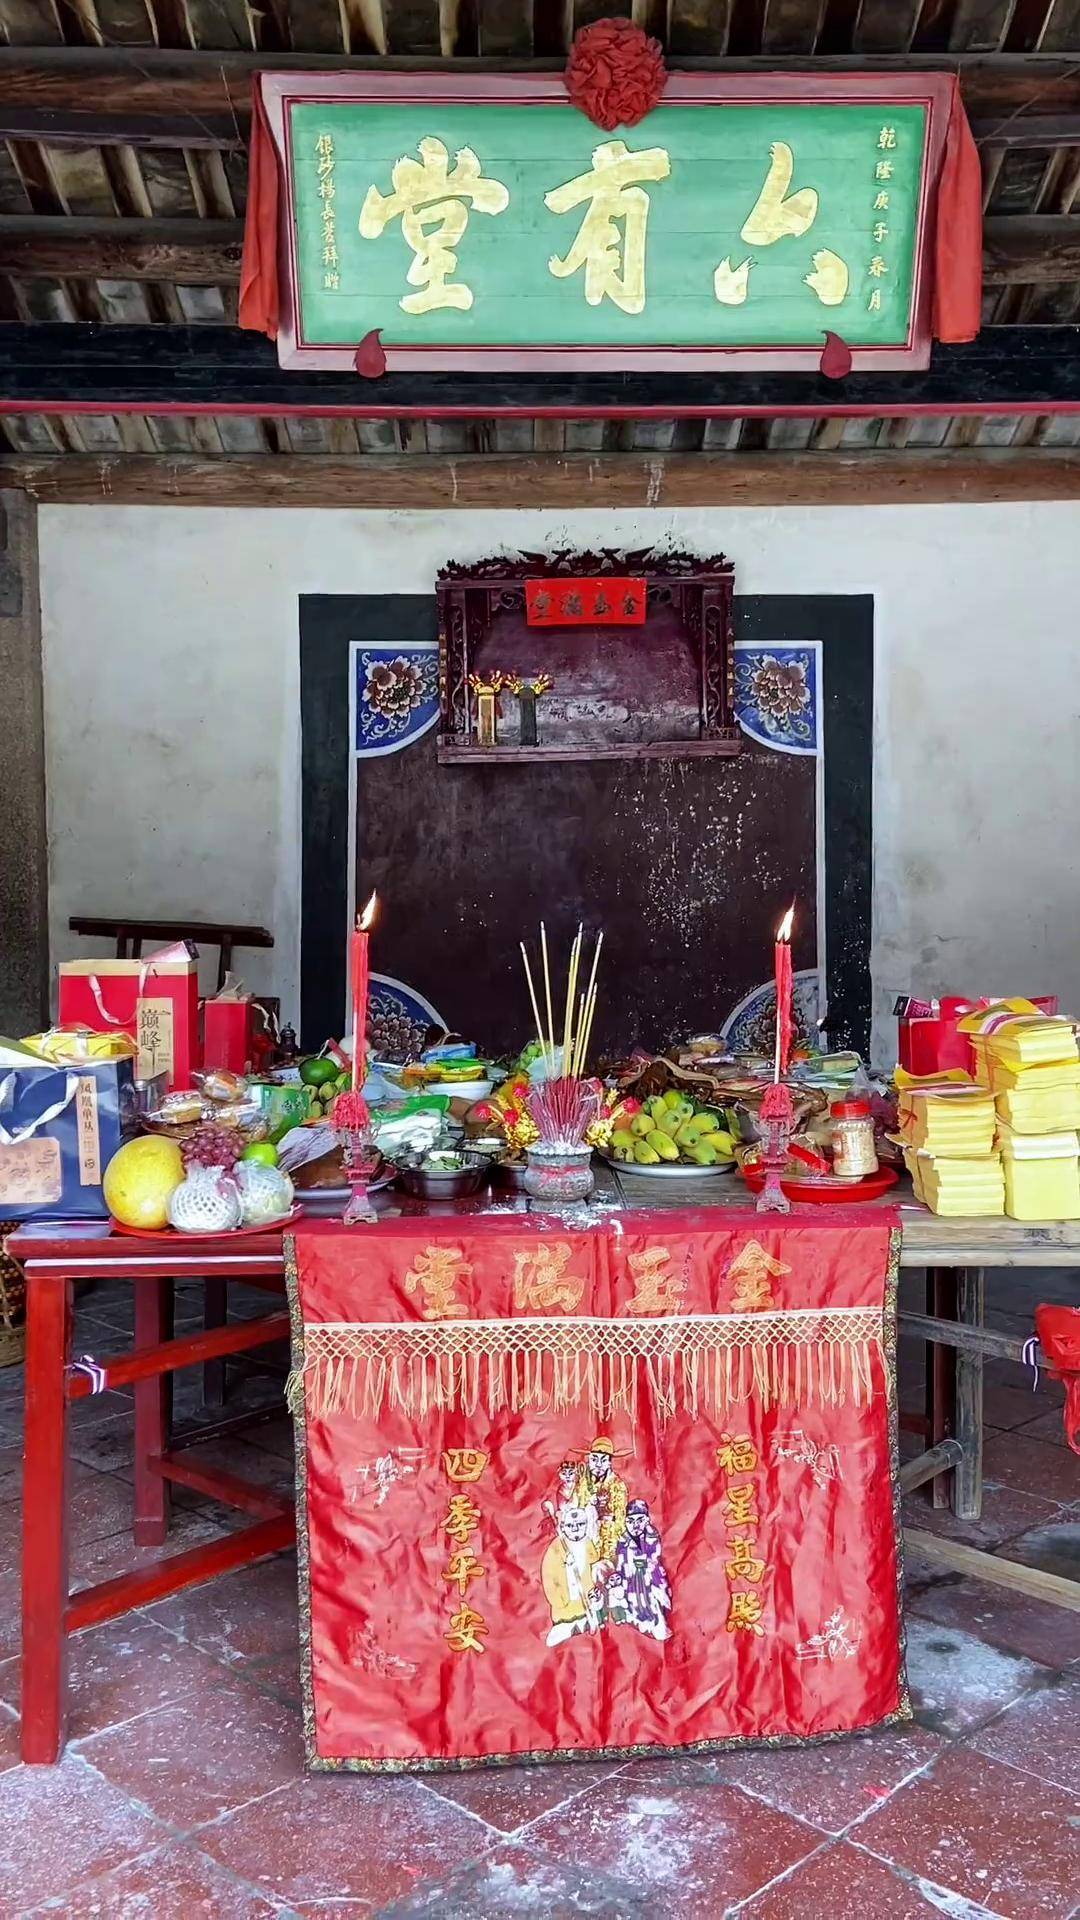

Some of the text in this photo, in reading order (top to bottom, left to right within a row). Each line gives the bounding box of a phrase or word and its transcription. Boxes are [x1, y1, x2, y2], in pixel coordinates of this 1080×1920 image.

[359, 135, 850, 315] 六有堂
[868, 127, 897, 312] 乾隆庚子春月
[440, 1447, 490, 1654] 四季平安
[717, 1432, 767, 1638] 福星高照
